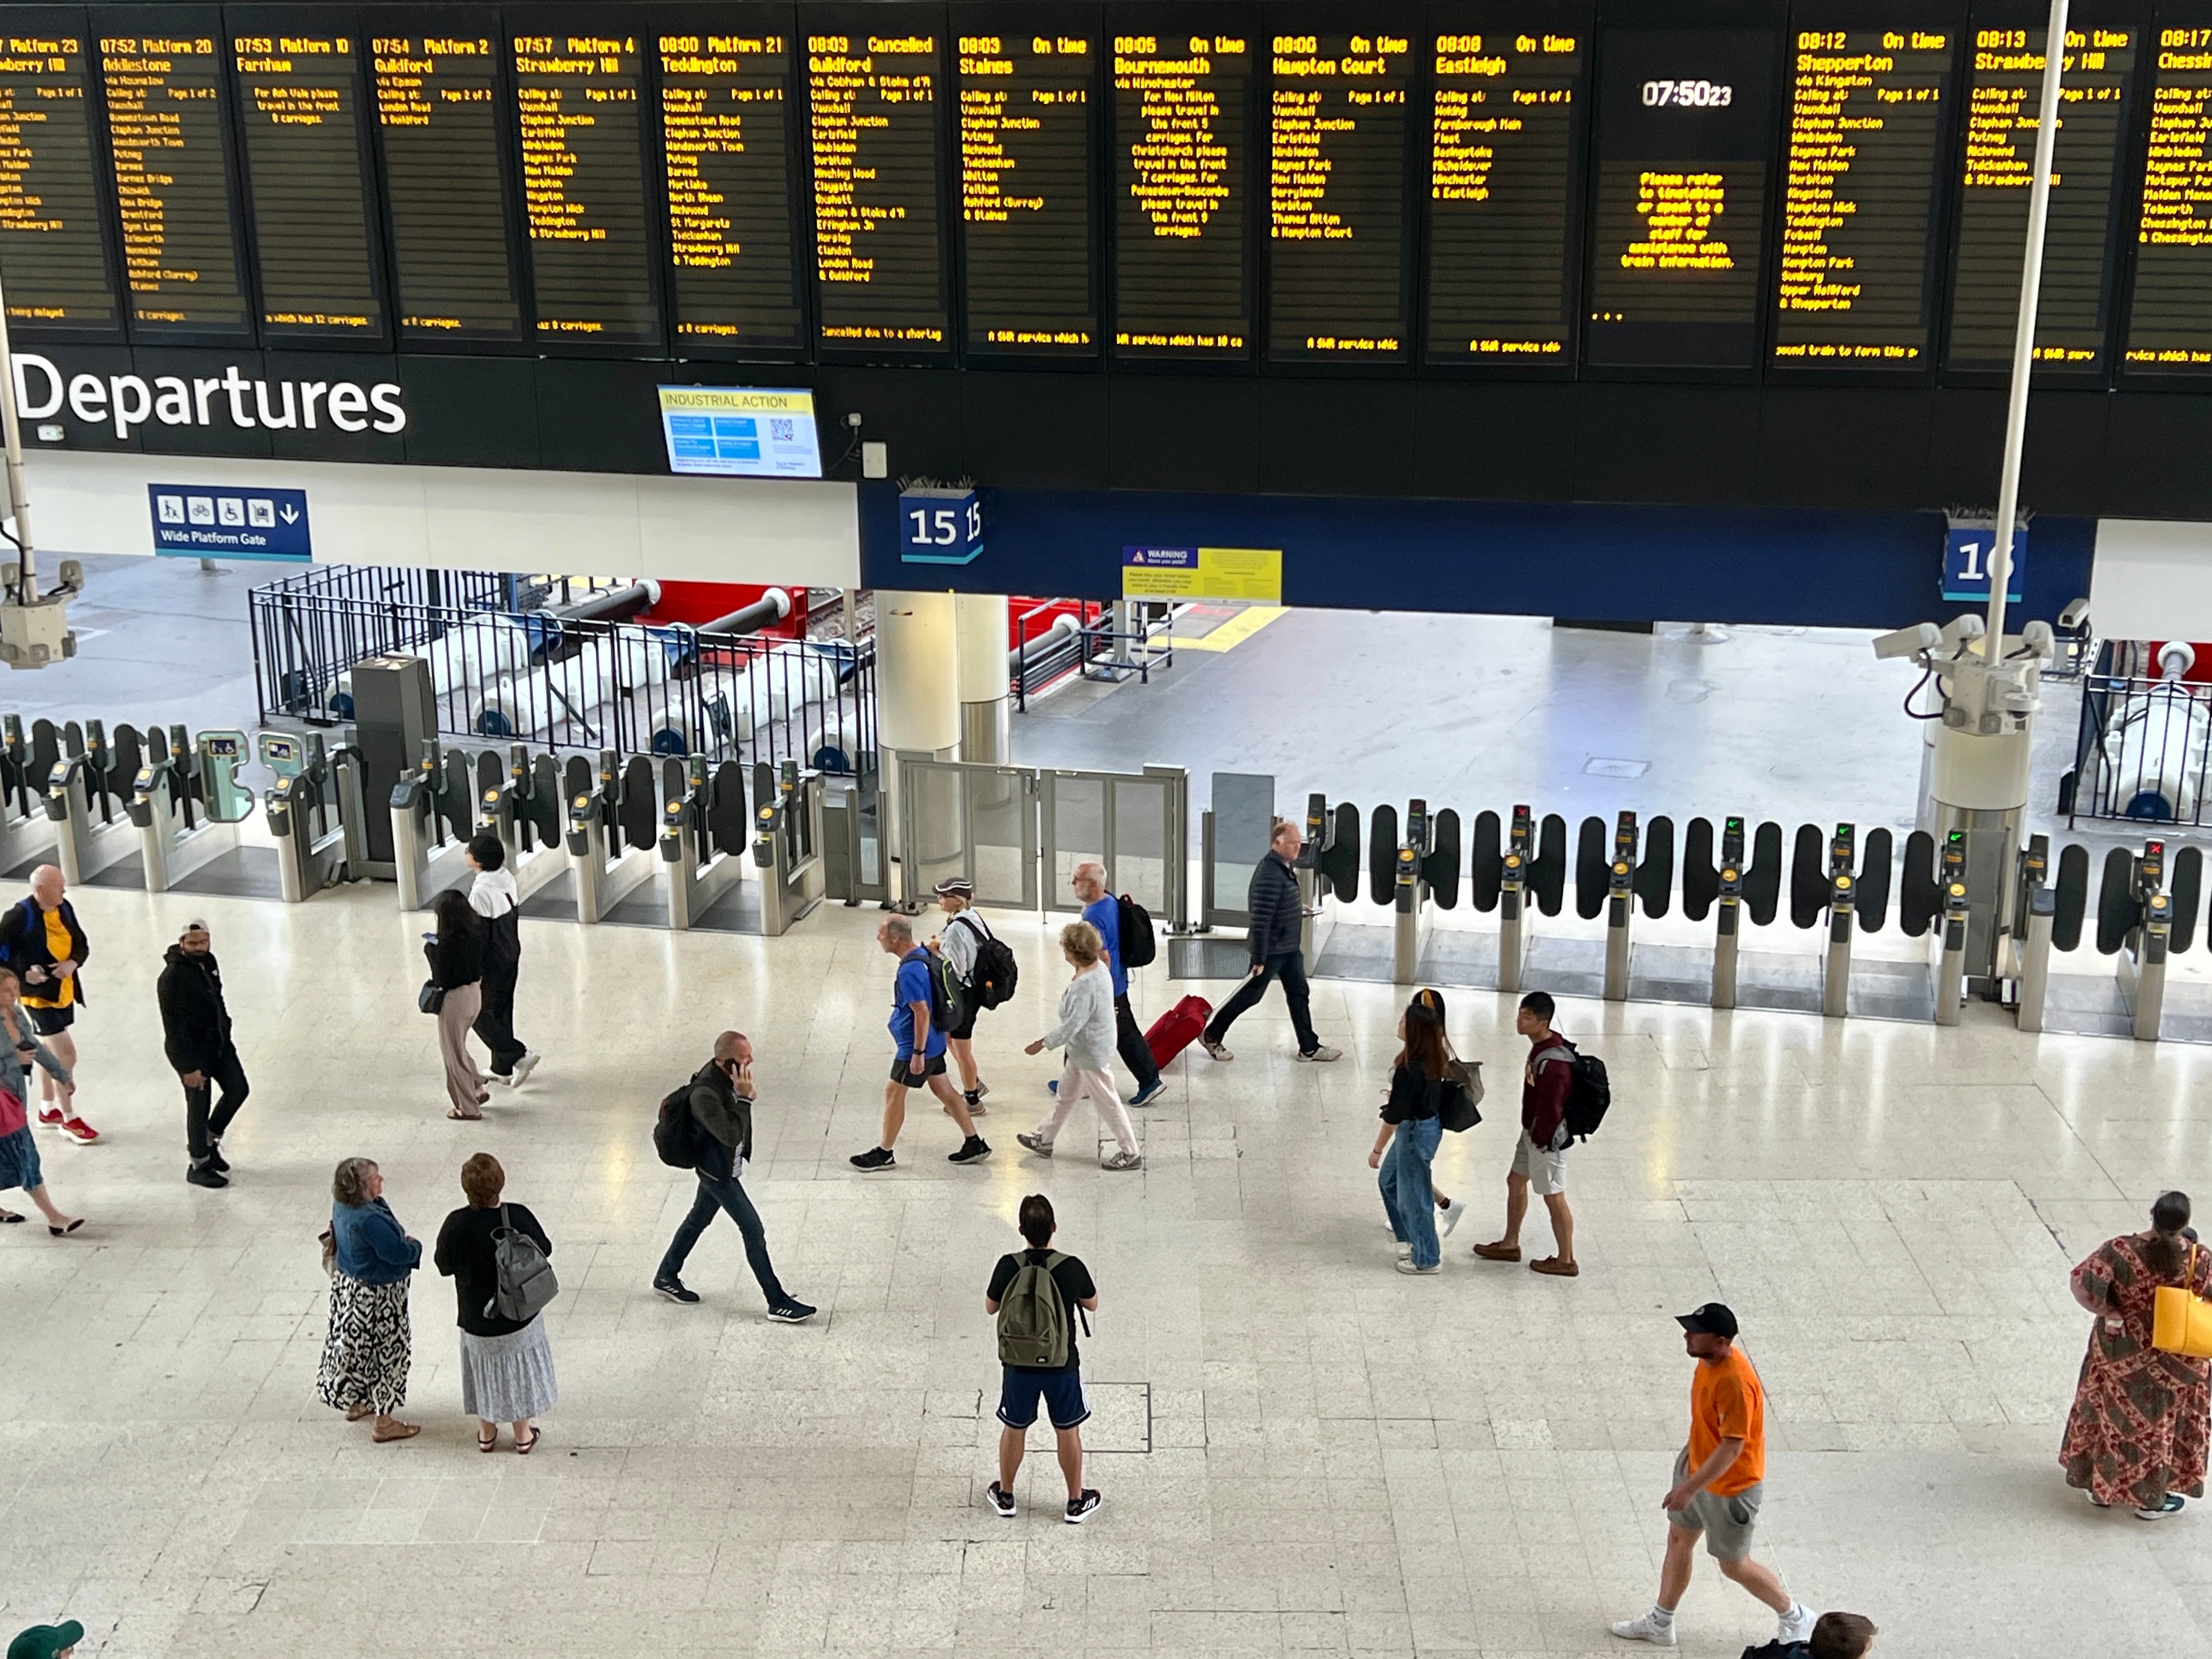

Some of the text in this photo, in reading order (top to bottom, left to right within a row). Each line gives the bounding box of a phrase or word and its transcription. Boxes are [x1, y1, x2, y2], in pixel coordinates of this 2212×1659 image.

[514, 37, 634, 53] 07:57 Platform 4
[708, 37, 761, 53] Platform
[766, 37, 781, 53] 21
[808, 36, 932, 53] 08:03 Cancelled
[959, 37, 1087, 54] 08:03 On time
[1115, 37, 1245, 53] 08:05 On time
[1351, 36, 1370, 53] On
[1377, 36, 1407, 53] time
[1516, 35, 1536, 52] On
[1543, 35, 1575, 53] time
[1798, 32, 1945, 49] 08:12 On time
[1977, 30, 2128, 48] 08:13 On time
[2161, 30, 2211, 46] 08:17
[516, 57, 595, 74] Strawberry
[661, 56, 737, 74] Teddington
[809, 57, 872, 73] Guildford
[960, 58, 1013, 74] Staines
[1115, 57, 1210, 74] Bournemouth
[1273, 57, 1386, 76] Hampton Court
[1436, 57, 1506, 76] Eastleigh
[1797, 54, 1893, 73] Shepperton
[1975, 53, 2075, 72] Strawbey
[10, 352, 407, 440] Departures
[665, 394, 788, 408] INDUSTRIAL ACTION
[910, 509, 957, 545] 15
[966, 501, 981, 542] 15
[160, 529, 266, 546] Wide Platform Gate
[1147, 550, 1188, 559] WARNING
